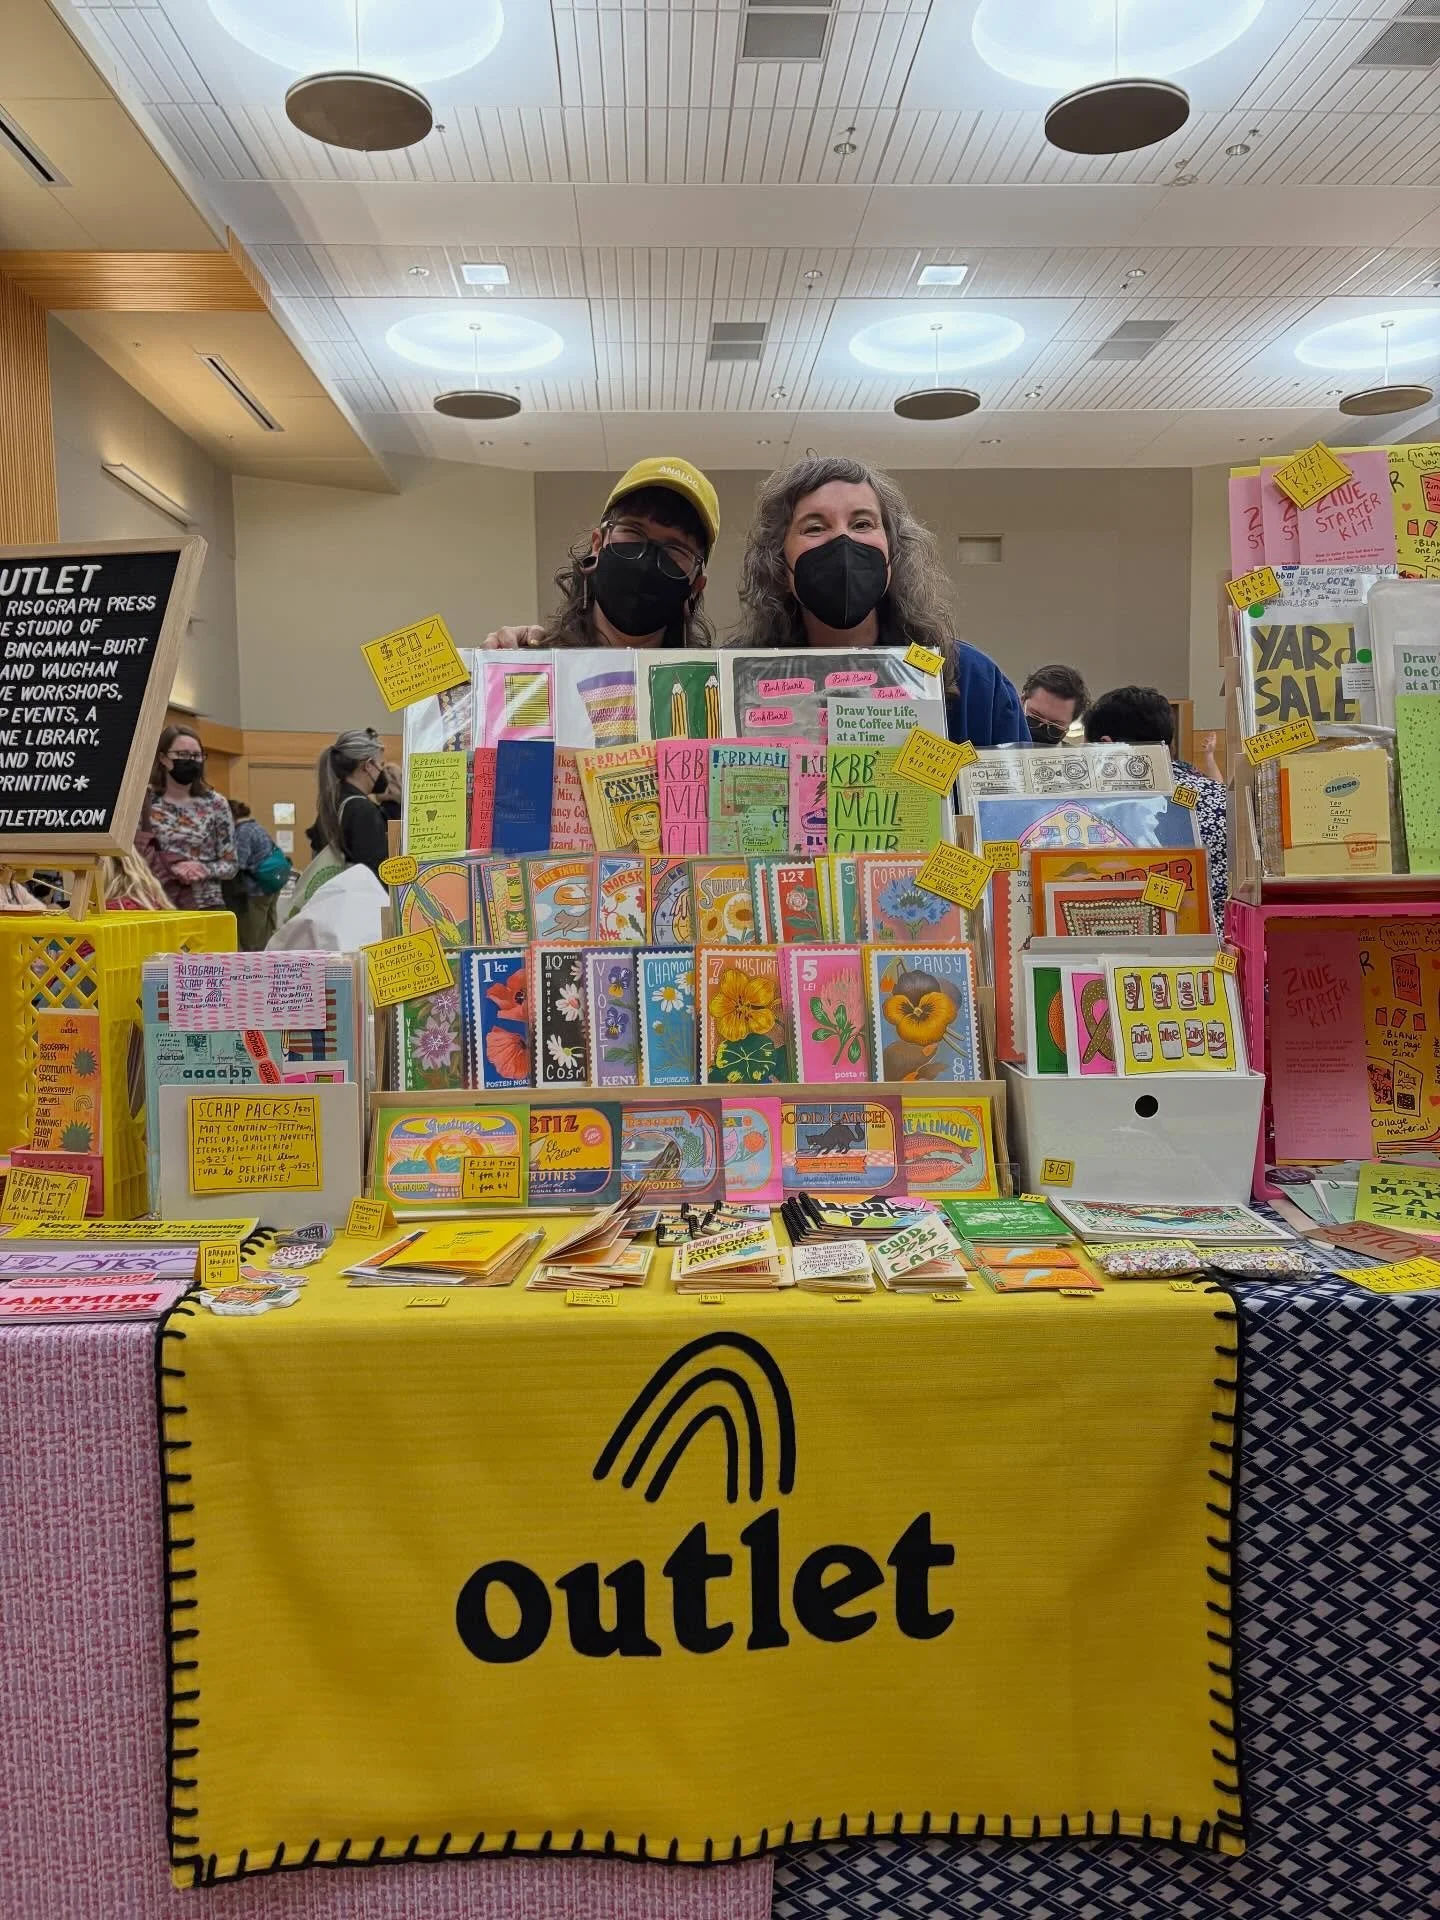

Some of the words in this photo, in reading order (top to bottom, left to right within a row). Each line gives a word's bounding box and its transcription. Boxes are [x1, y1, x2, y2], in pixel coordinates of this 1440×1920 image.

[1283, 449, 1321, 480] ZINE!
[1292, 463, 1324, 489] KIT!
[1315, 492, 1383, 533] STARTER
[1338, 516, 1373, 541] KIT!
[6, 597, 100, 617] RISOGRAPH
[107, 596, 156, 612] PRESS
[15, 619, 72, 637] STUDIO
[79, 618, 102, 635] OF
[380, 632, 422, 661] $20
[1403, 653, 1436, 663] Draw
[41, 661, 118, 679] VAUGHAN
[1404, 666, 1428, 677] One
[20, 683, 123, 702] WORKSHOPS,
[1406, 680, 1418, 690] at
[1254, 674, 1356, 722] SALE
[11, 706, 80, 724] EVENTS,
[85, 705, 97, 722] A
[836, 705, 865, 717] Draw
[866, 706, 892, 717] Your
[893, 705, 918, 718] Life,
[836, 719, 857, 730] One
[859, 718, 893, 730] Coffee
[25, 728, 100, 747] LIBRARY,
[837, 731, 849, 742] at
[850, 733, 857, 742] a
[857, 731, 885, 742] Time
[1249, 728, 1287, 747] CHEESE
[35, 751, 76, 768] TONS
[664, 749, 704, 780] KBB
[750, 752, 788, 768] MAIL
[1325, 780, 1358, 793] Cheese
[835, 791, 900, 828] MAIL
[940, 846, 970, 864] VINTAGE
[1153, 884, 1168, 896] $15
[370, 941, 413, 960] VINTAGE
[374, 951, 423, 973] PACKAGING
[709, 959, 724, 977] 7
[802, 960, 818, 981] 5
[914, 956, 962, 974] PANSY
[178, 965, 225, 977] RISOGRAPH
[179, 979, 204, 989] SCRAP
[206, 978, 225, 988] PACK
[1284, 964, 1337, 997] ZINE
[1286, 978, 1351, 1018] STARTER
[595, 962, 609, 1062] VIOLET
[38, 1074, 58, 1083] SPACE
[485, 1080, 512, 1089] POSTEN
[834, 1071, 858, 1081] posta
[199, 1102, 240, 1119] SCRAP
[830, 1110, 887, 1124] CATCH
[200, 1125, 221, 1134] MAY
[227, 1124, 267, 1133] CONTAIN
[1371, 1118, 1409, 1131] Collage
[242, 1133, 278, 1142] QUALITY
[256, 1152, 273, 1161] ALL
[469, 1160, 495, 1168] FISH
[239, 1163, 276, 1173] DELIGHT
[1048, 1162, 1066, 1176] $15
[237, 1172, 291, 1184] SURPRISE!
[1405, 1199, 1428, 1208] A
[38, 1222, 82, 1230] Keep
[88, 1222, 164, 1230] Honking!
[877, 1227, 923, 1255] GOOD
[890, 1242, 950, 1274] CATS
[456, 1508, 954, 1663] outlet
